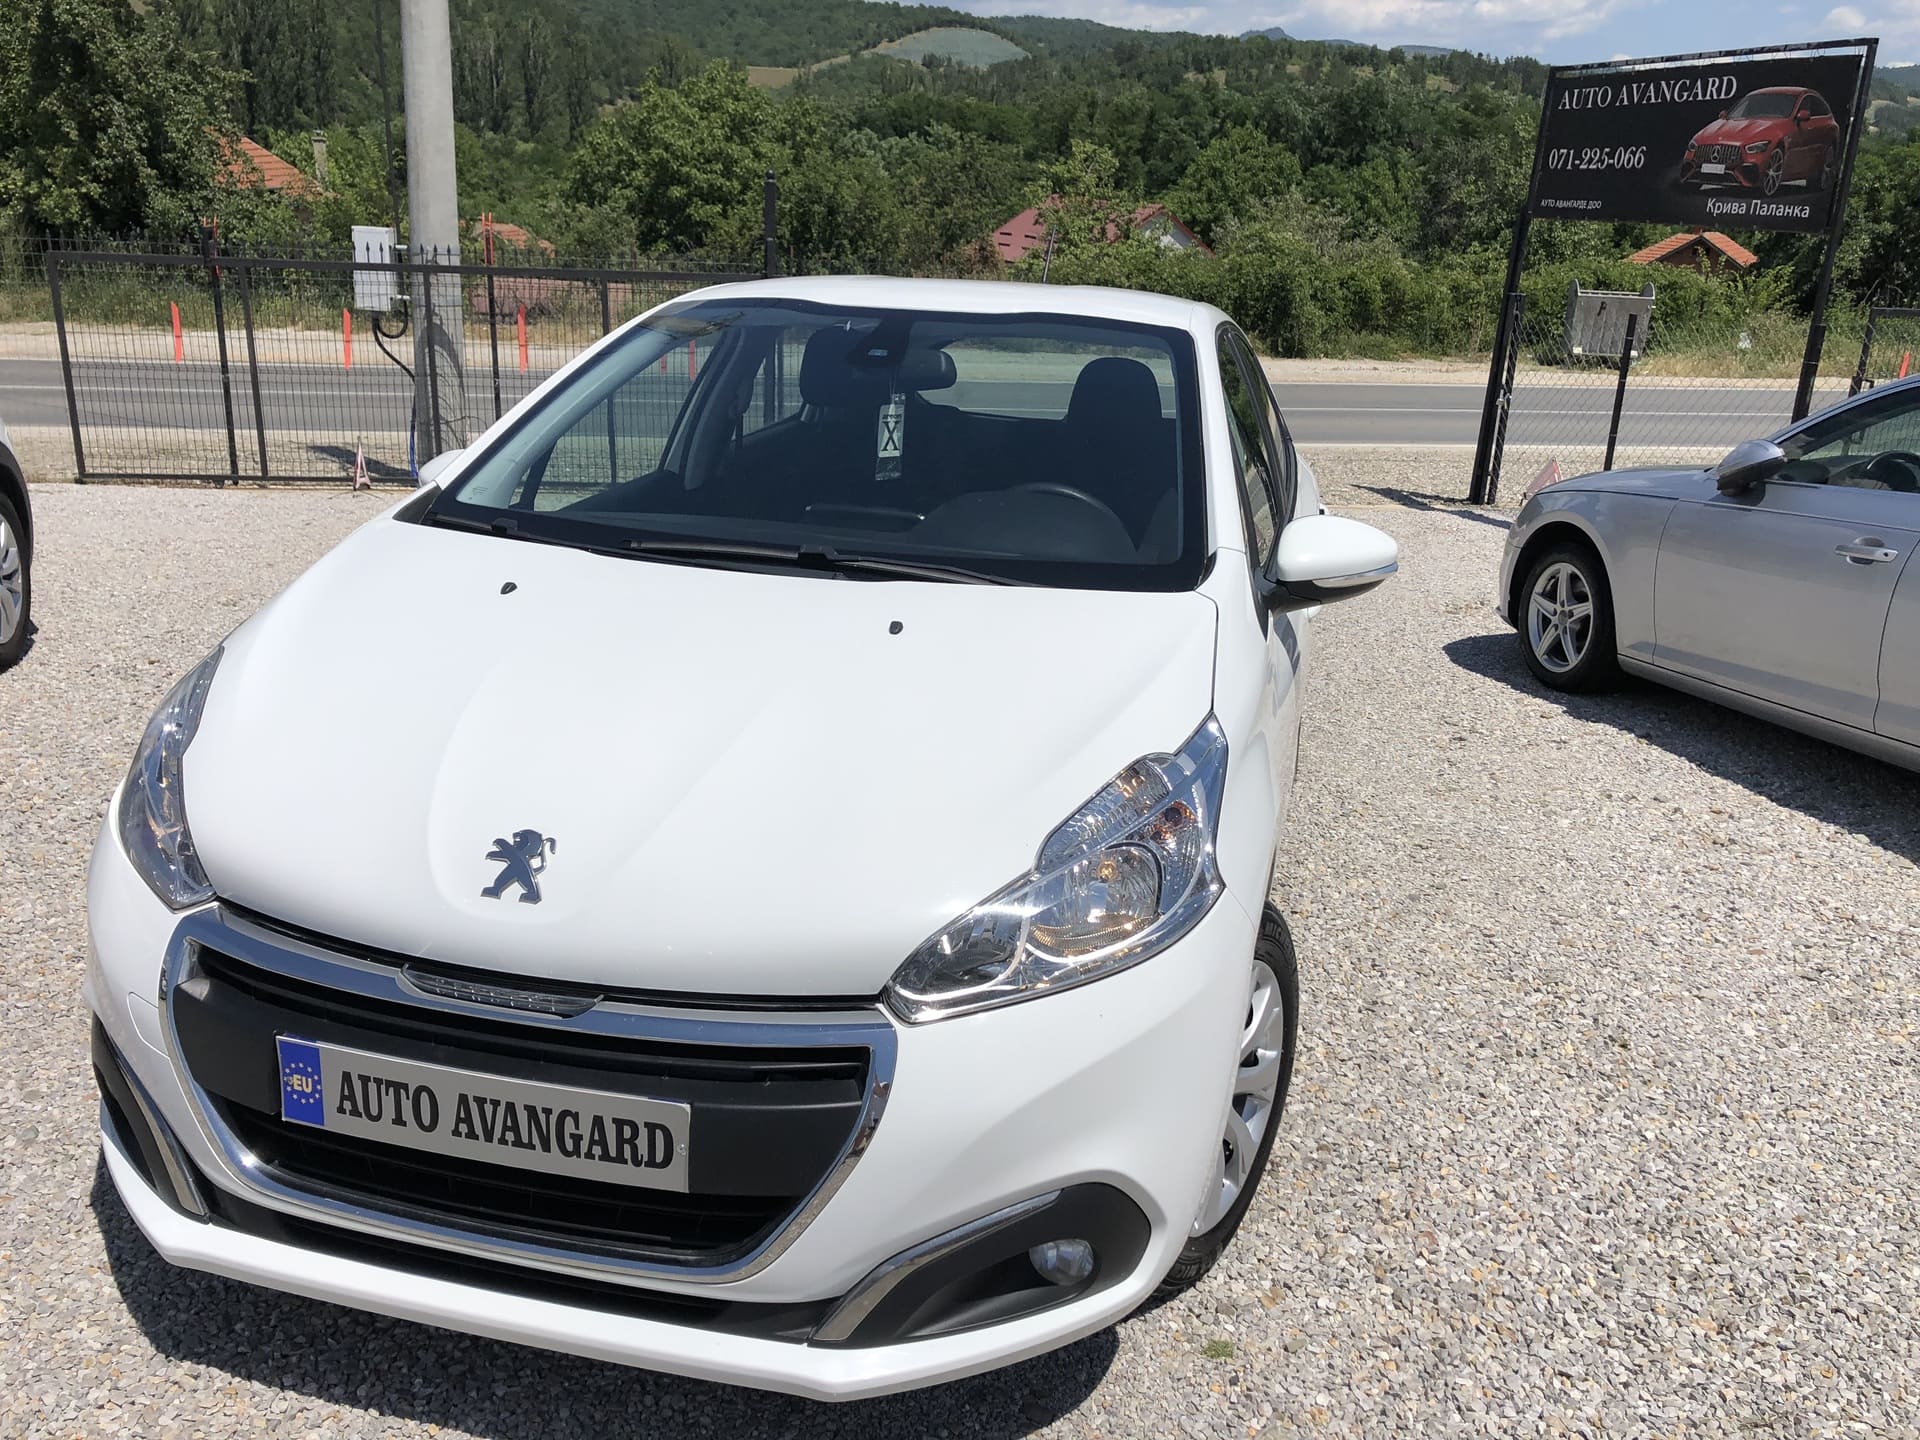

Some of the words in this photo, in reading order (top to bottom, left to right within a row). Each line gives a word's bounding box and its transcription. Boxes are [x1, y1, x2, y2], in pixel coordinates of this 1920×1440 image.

[1558, 85, 1612, 110] AUTO
[1615, 75, 1737, 107] AVANGARD
[1548, 145, 1647, 170] 071-225-066
[1540, 199, 1556, 208] АУТО
[1586, 200, 1602, 210] ДОО
[1706, 197, 1747, 217] Крива
[1750, 199, 1810, 218] Паланка
[879, 420, 901, 452] X
[293, 1074, 313, 1094] EU
[336, 1070, 440, 1134] AUTO
[451, 1092, 675, 1170] AVANGARD
